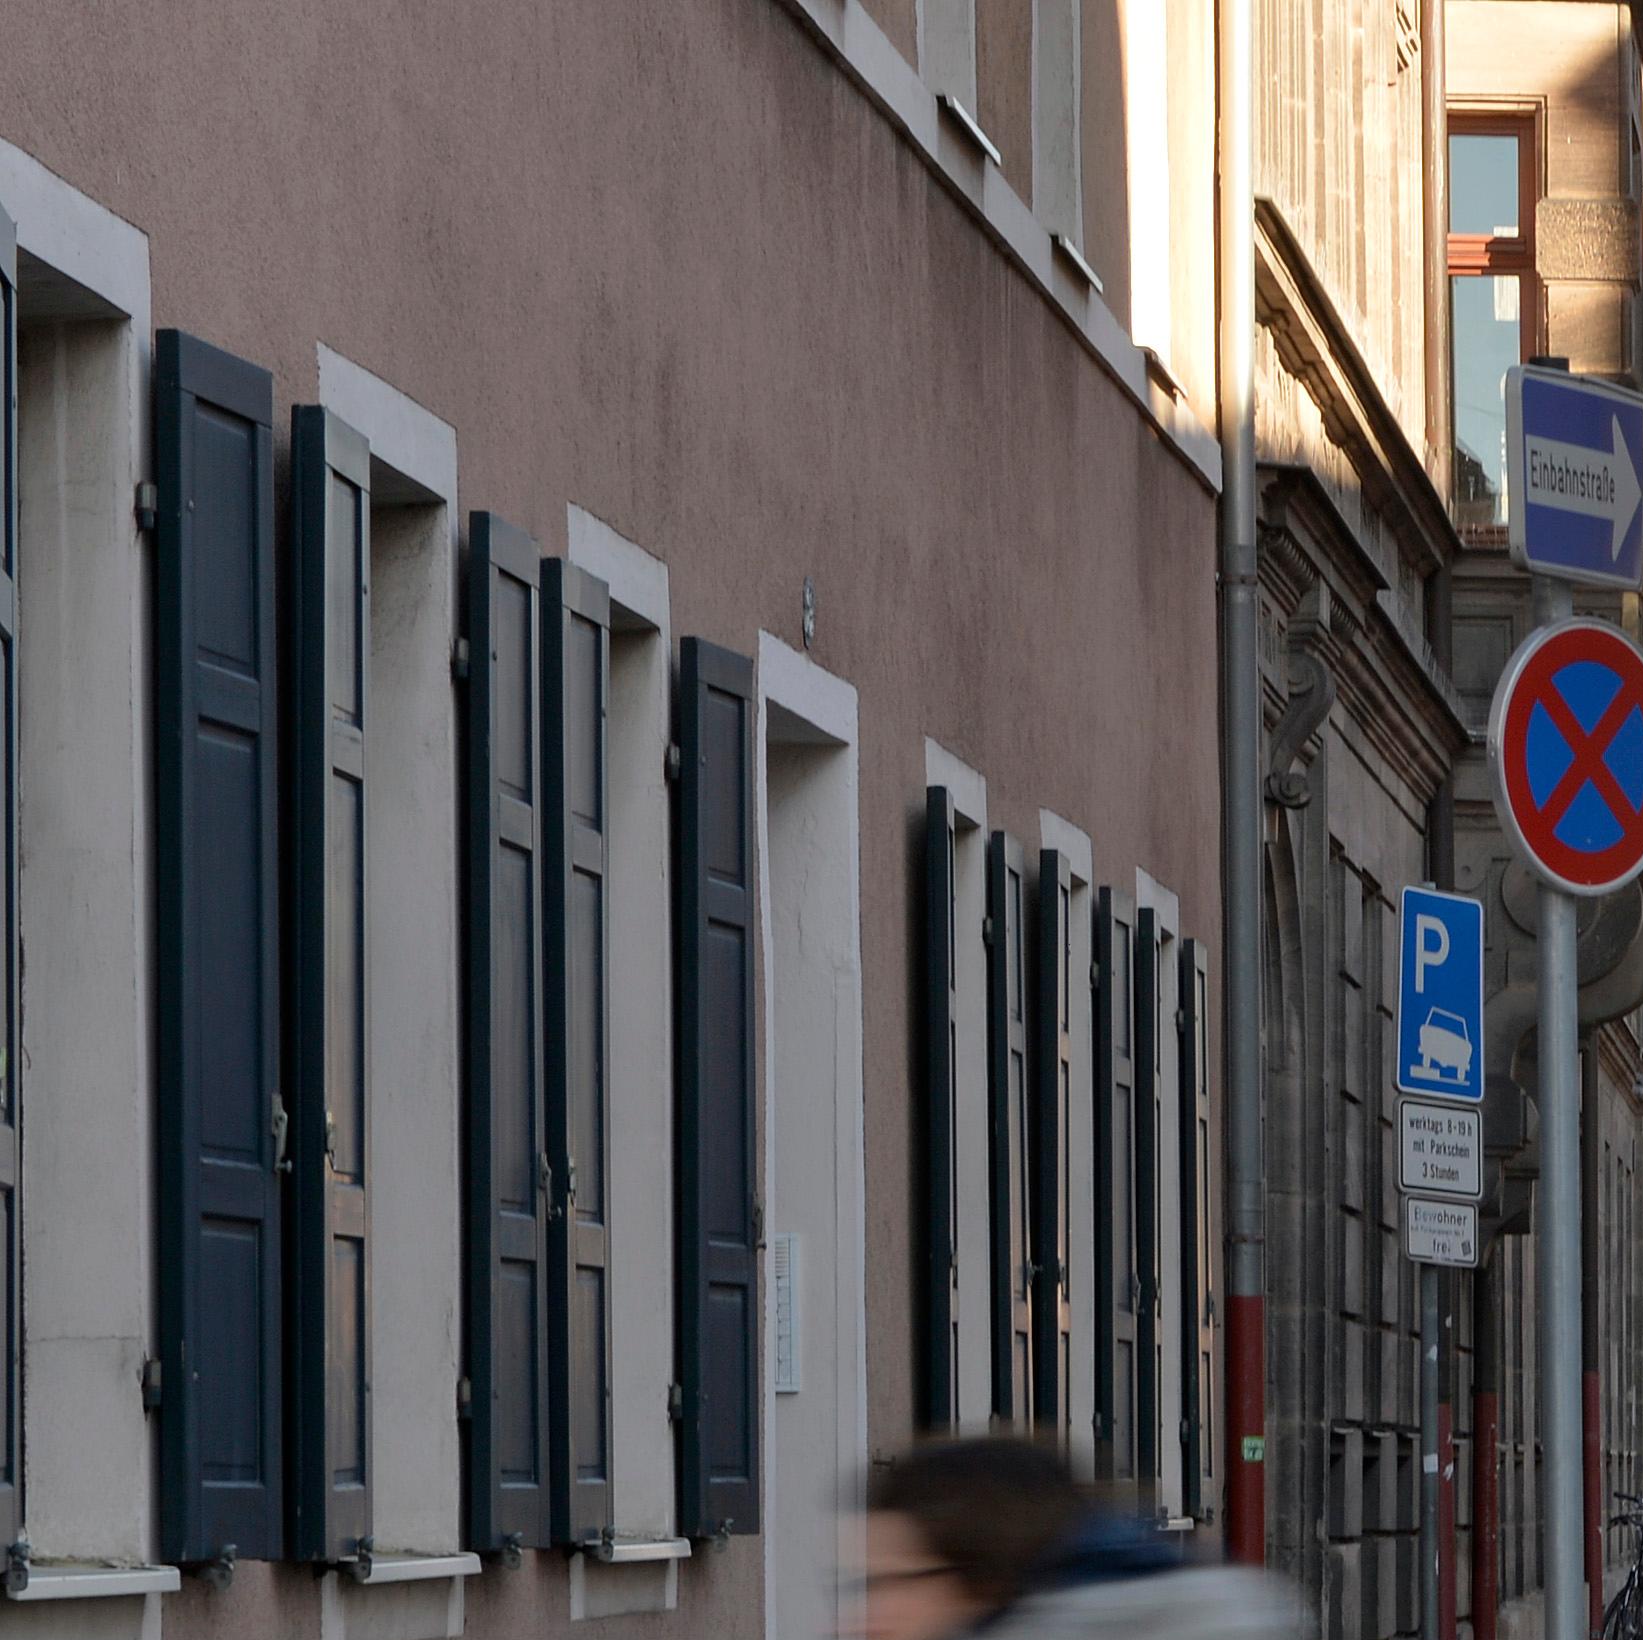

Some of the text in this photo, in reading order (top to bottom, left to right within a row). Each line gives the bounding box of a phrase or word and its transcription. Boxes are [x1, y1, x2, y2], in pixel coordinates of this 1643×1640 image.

[1530, 449, 1616, 505] Einbahnstraße
[1414, 912, 1450, 994] P
[1409, 1117, 1443, 1135] werktags
[1430, 1140, 1470, 1159] Parkschein
[1422, 1162, 1460, 1181] 3 Stunden
[1414, 1206, 1468, 1227] Bewohner
